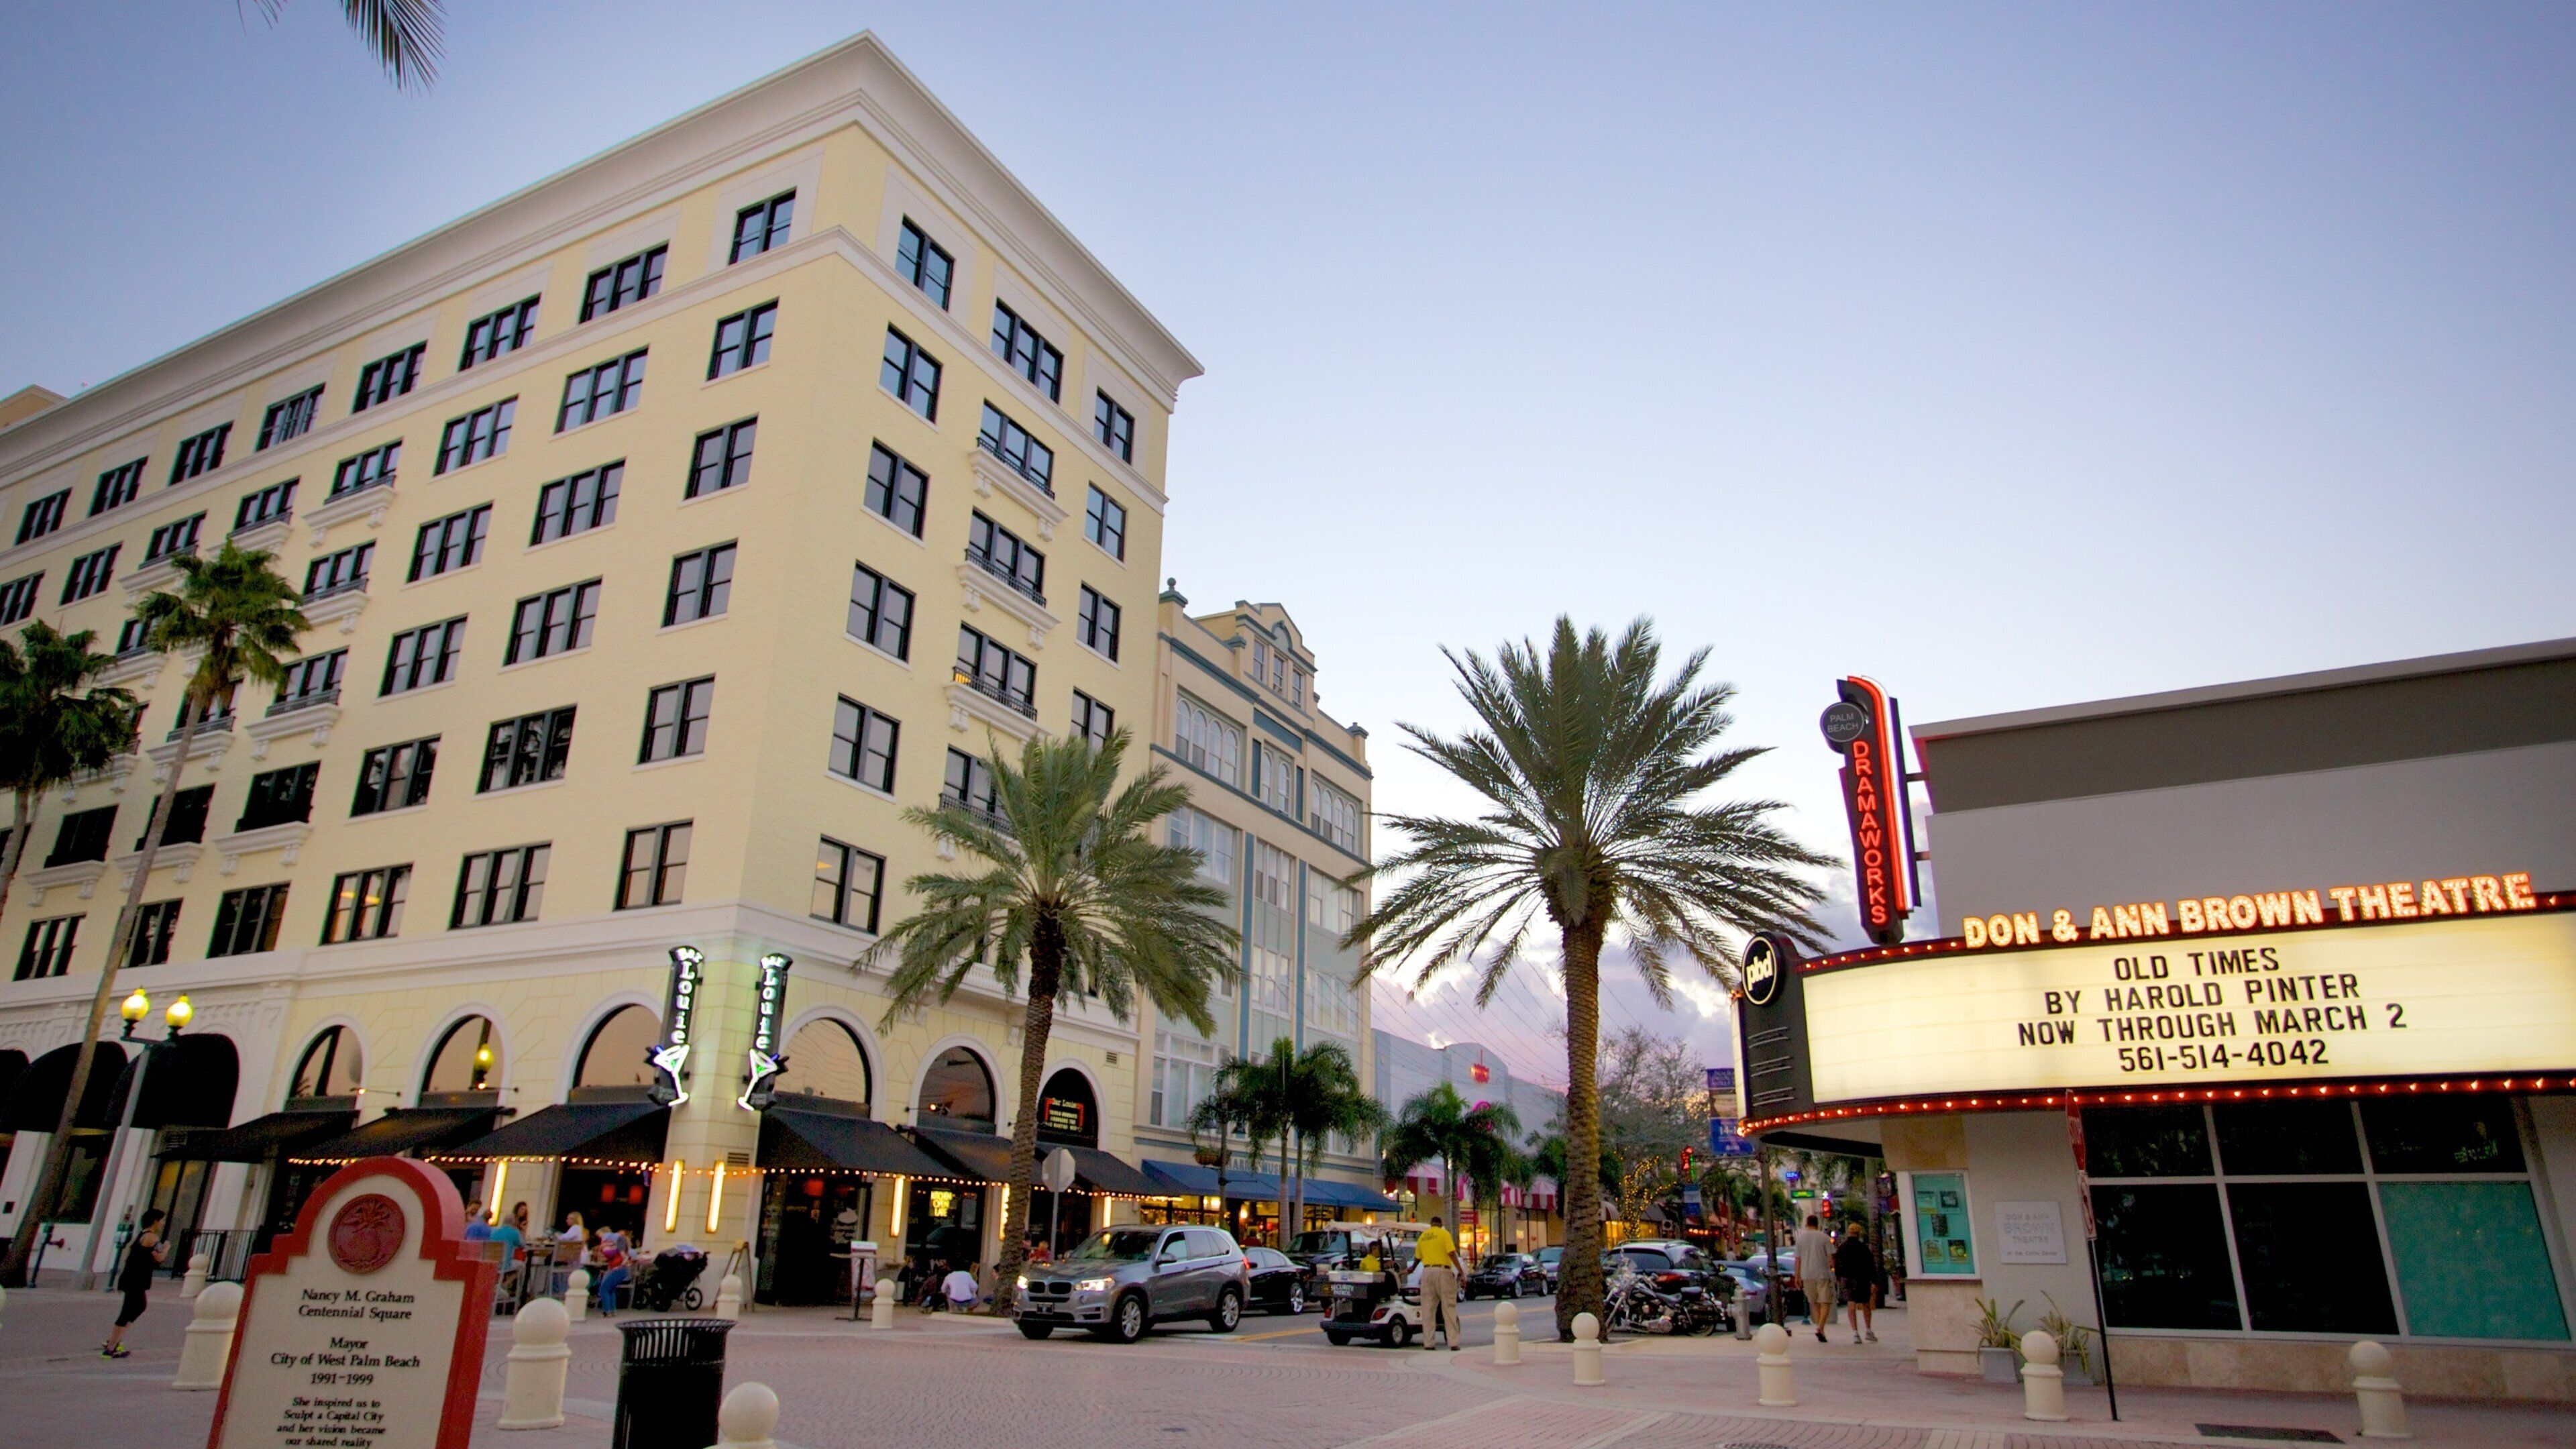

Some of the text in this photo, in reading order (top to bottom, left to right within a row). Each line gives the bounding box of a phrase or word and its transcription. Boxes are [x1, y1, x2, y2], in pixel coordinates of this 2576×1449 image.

[1829, 712, 1854, 724] PALM
[1827, 721, 1860, 733] BEACH
[1853, 741, 1888, 926] DRAMAWORKS
[1962, 872, 2536, 949] DON & ANN BROWN THEATRE
[1746, 952, 1773, 991] pbd
[2114, 947, 2279, 981] OLD TIMES
[2045, 973, 2360, 1016] BY HAROLD PINTER
[2017, 1003, 2407, 1046] NOW THROUGH MARCH 2
[2118, 1039, 2329, 1071] 561-514-4042
[302, 1289, 415, 1304] Nancy M. Graham
[299, 1305, 412, 1322] Centennial Square
[330, 1337, 369, 1350] Mayor
[270, 1353, 421, 1368] City of West Palm Beach
[310, 1373, 374, 1386] 1991-1999
[292, 1397, 381, 1409] She inspired us to
[284, 1410, 314, 1422] Sculpt
[327, 1411, 360, 1422] Capital
[364, 1411, 384, 1423] City
[276, 1424, 386, 1436] and her vision became
[306, 1438, 337, 1447] shared
[341, 1438, 372, 1449] reality
